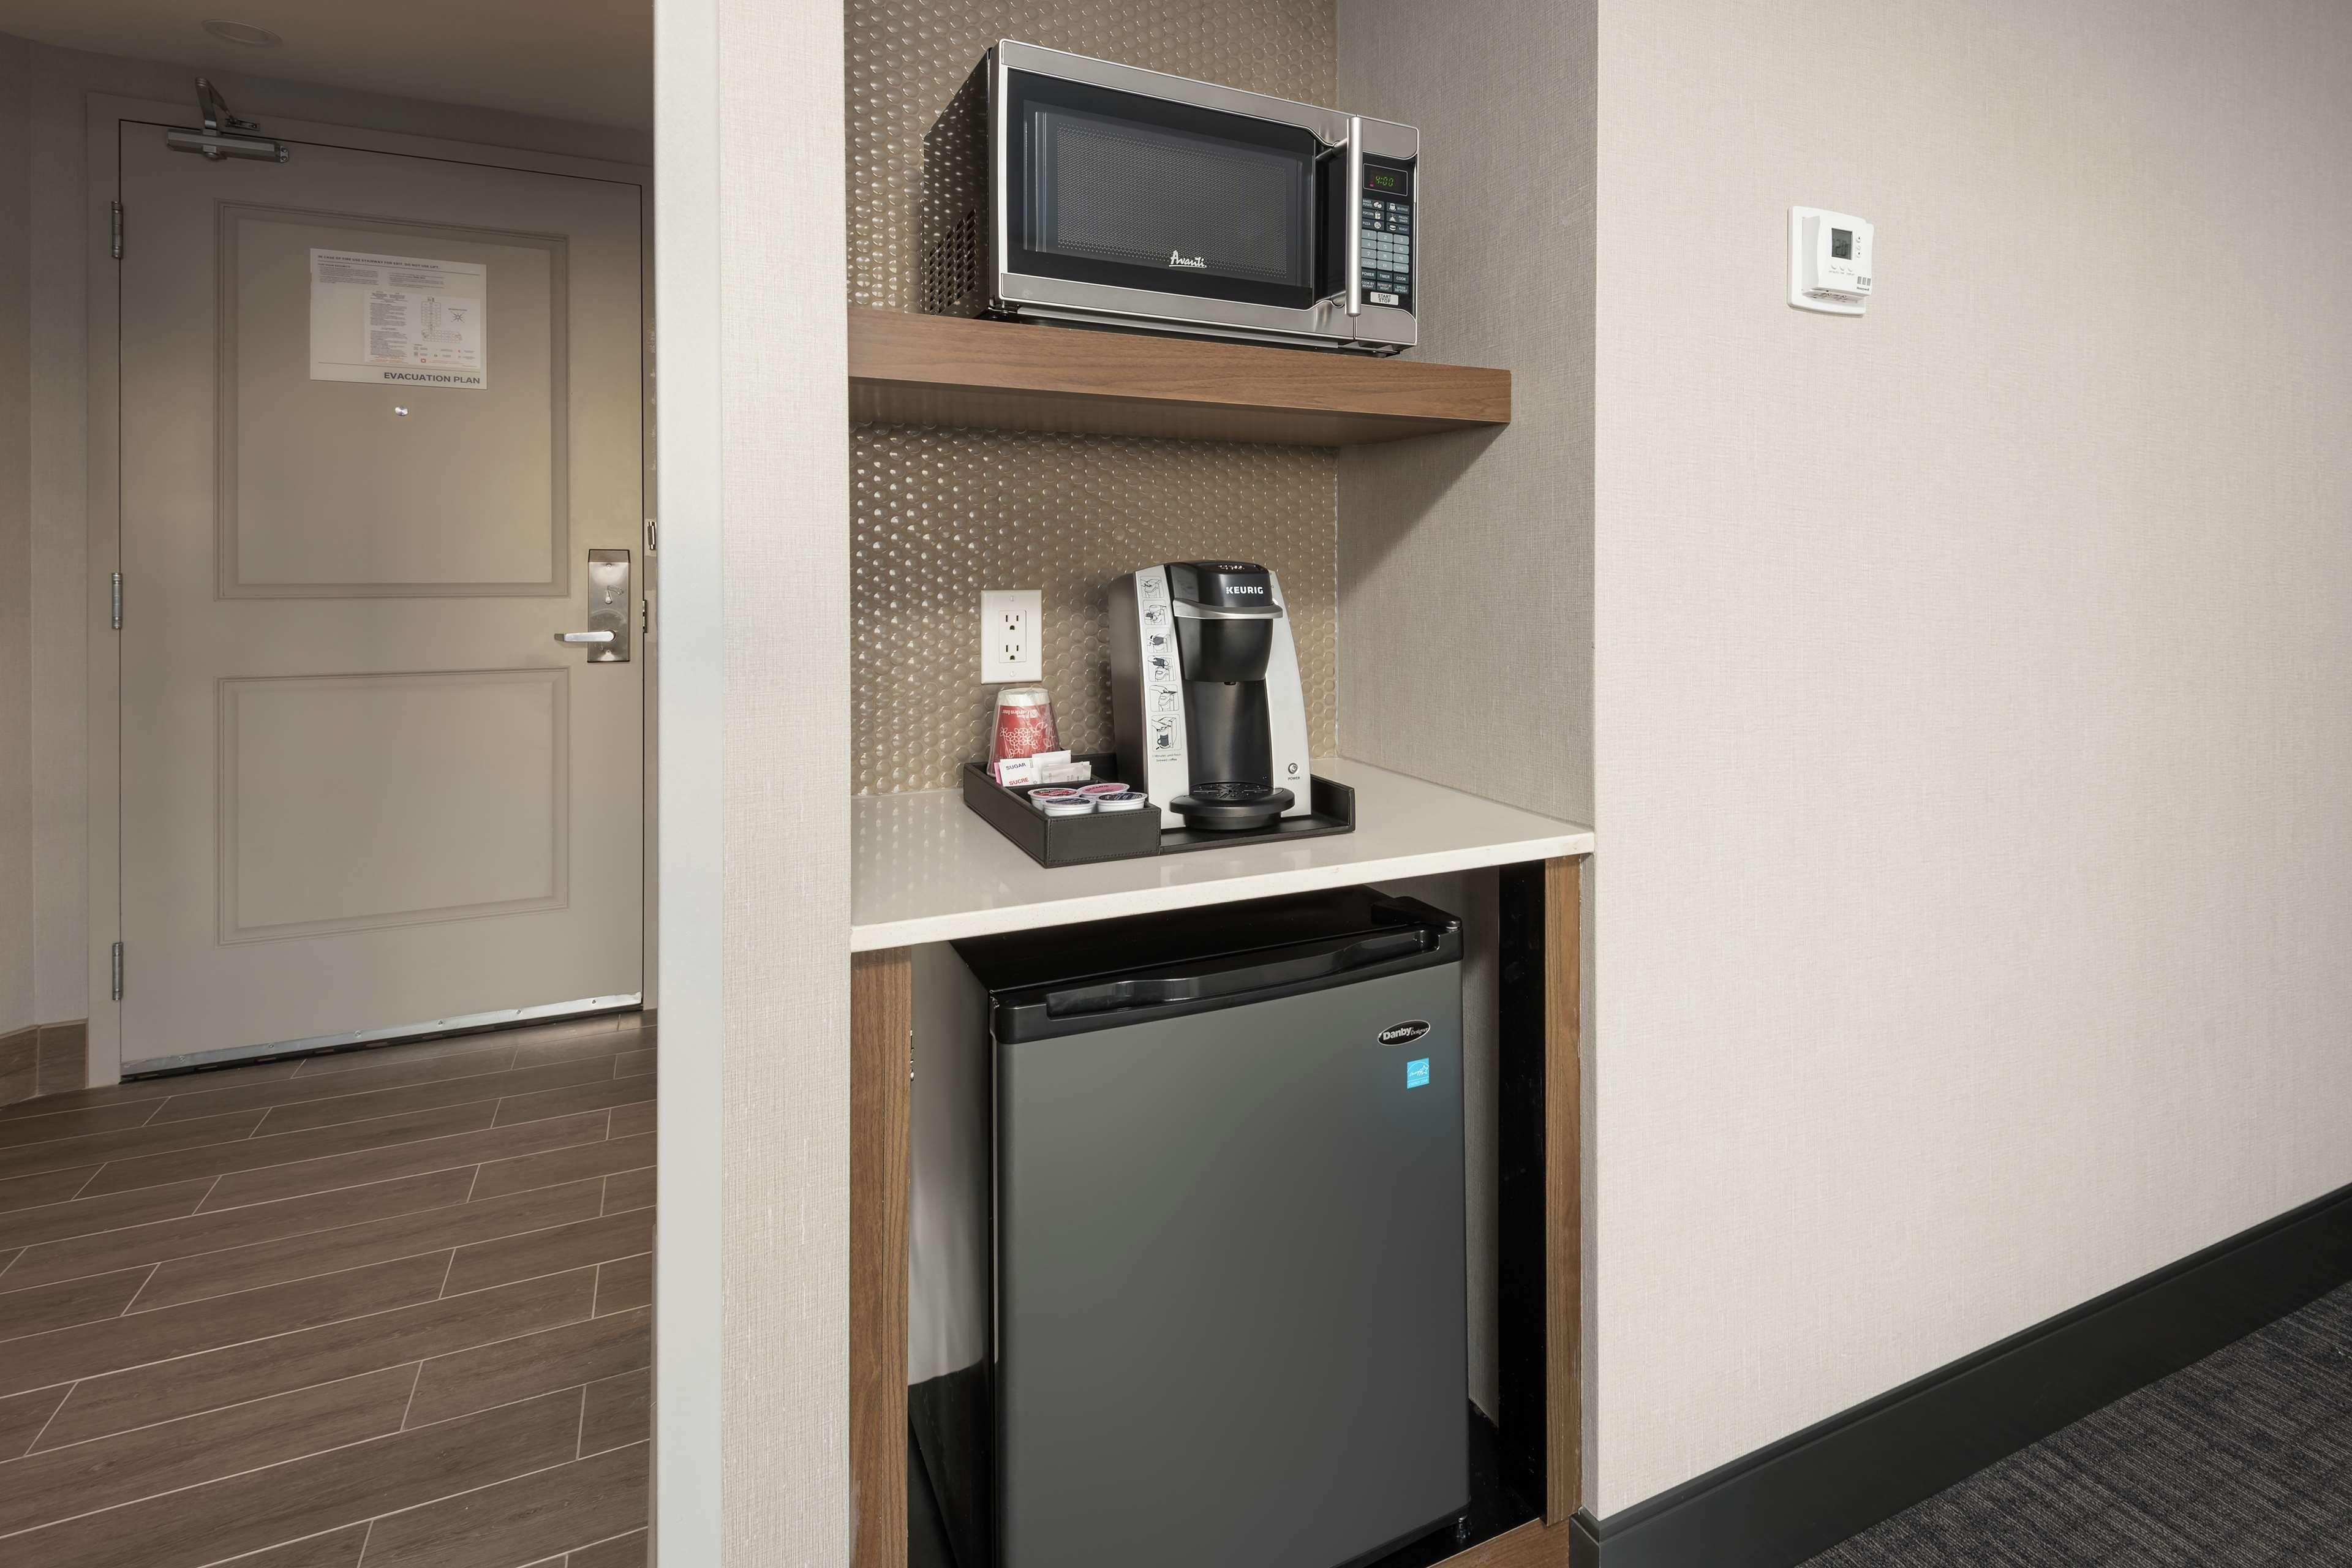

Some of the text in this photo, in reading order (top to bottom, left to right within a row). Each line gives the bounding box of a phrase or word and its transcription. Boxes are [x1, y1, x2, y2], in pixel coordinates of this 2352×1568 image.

[1376, 176, 1394, 187] 4:00
[1169, 250, 1205, 267] Avanti
[384, 372, 451, 382] EVACUATION
[1006, 762, 1027, 771] SUGAR
[1382, 1027, 1412, 1041] Danby
